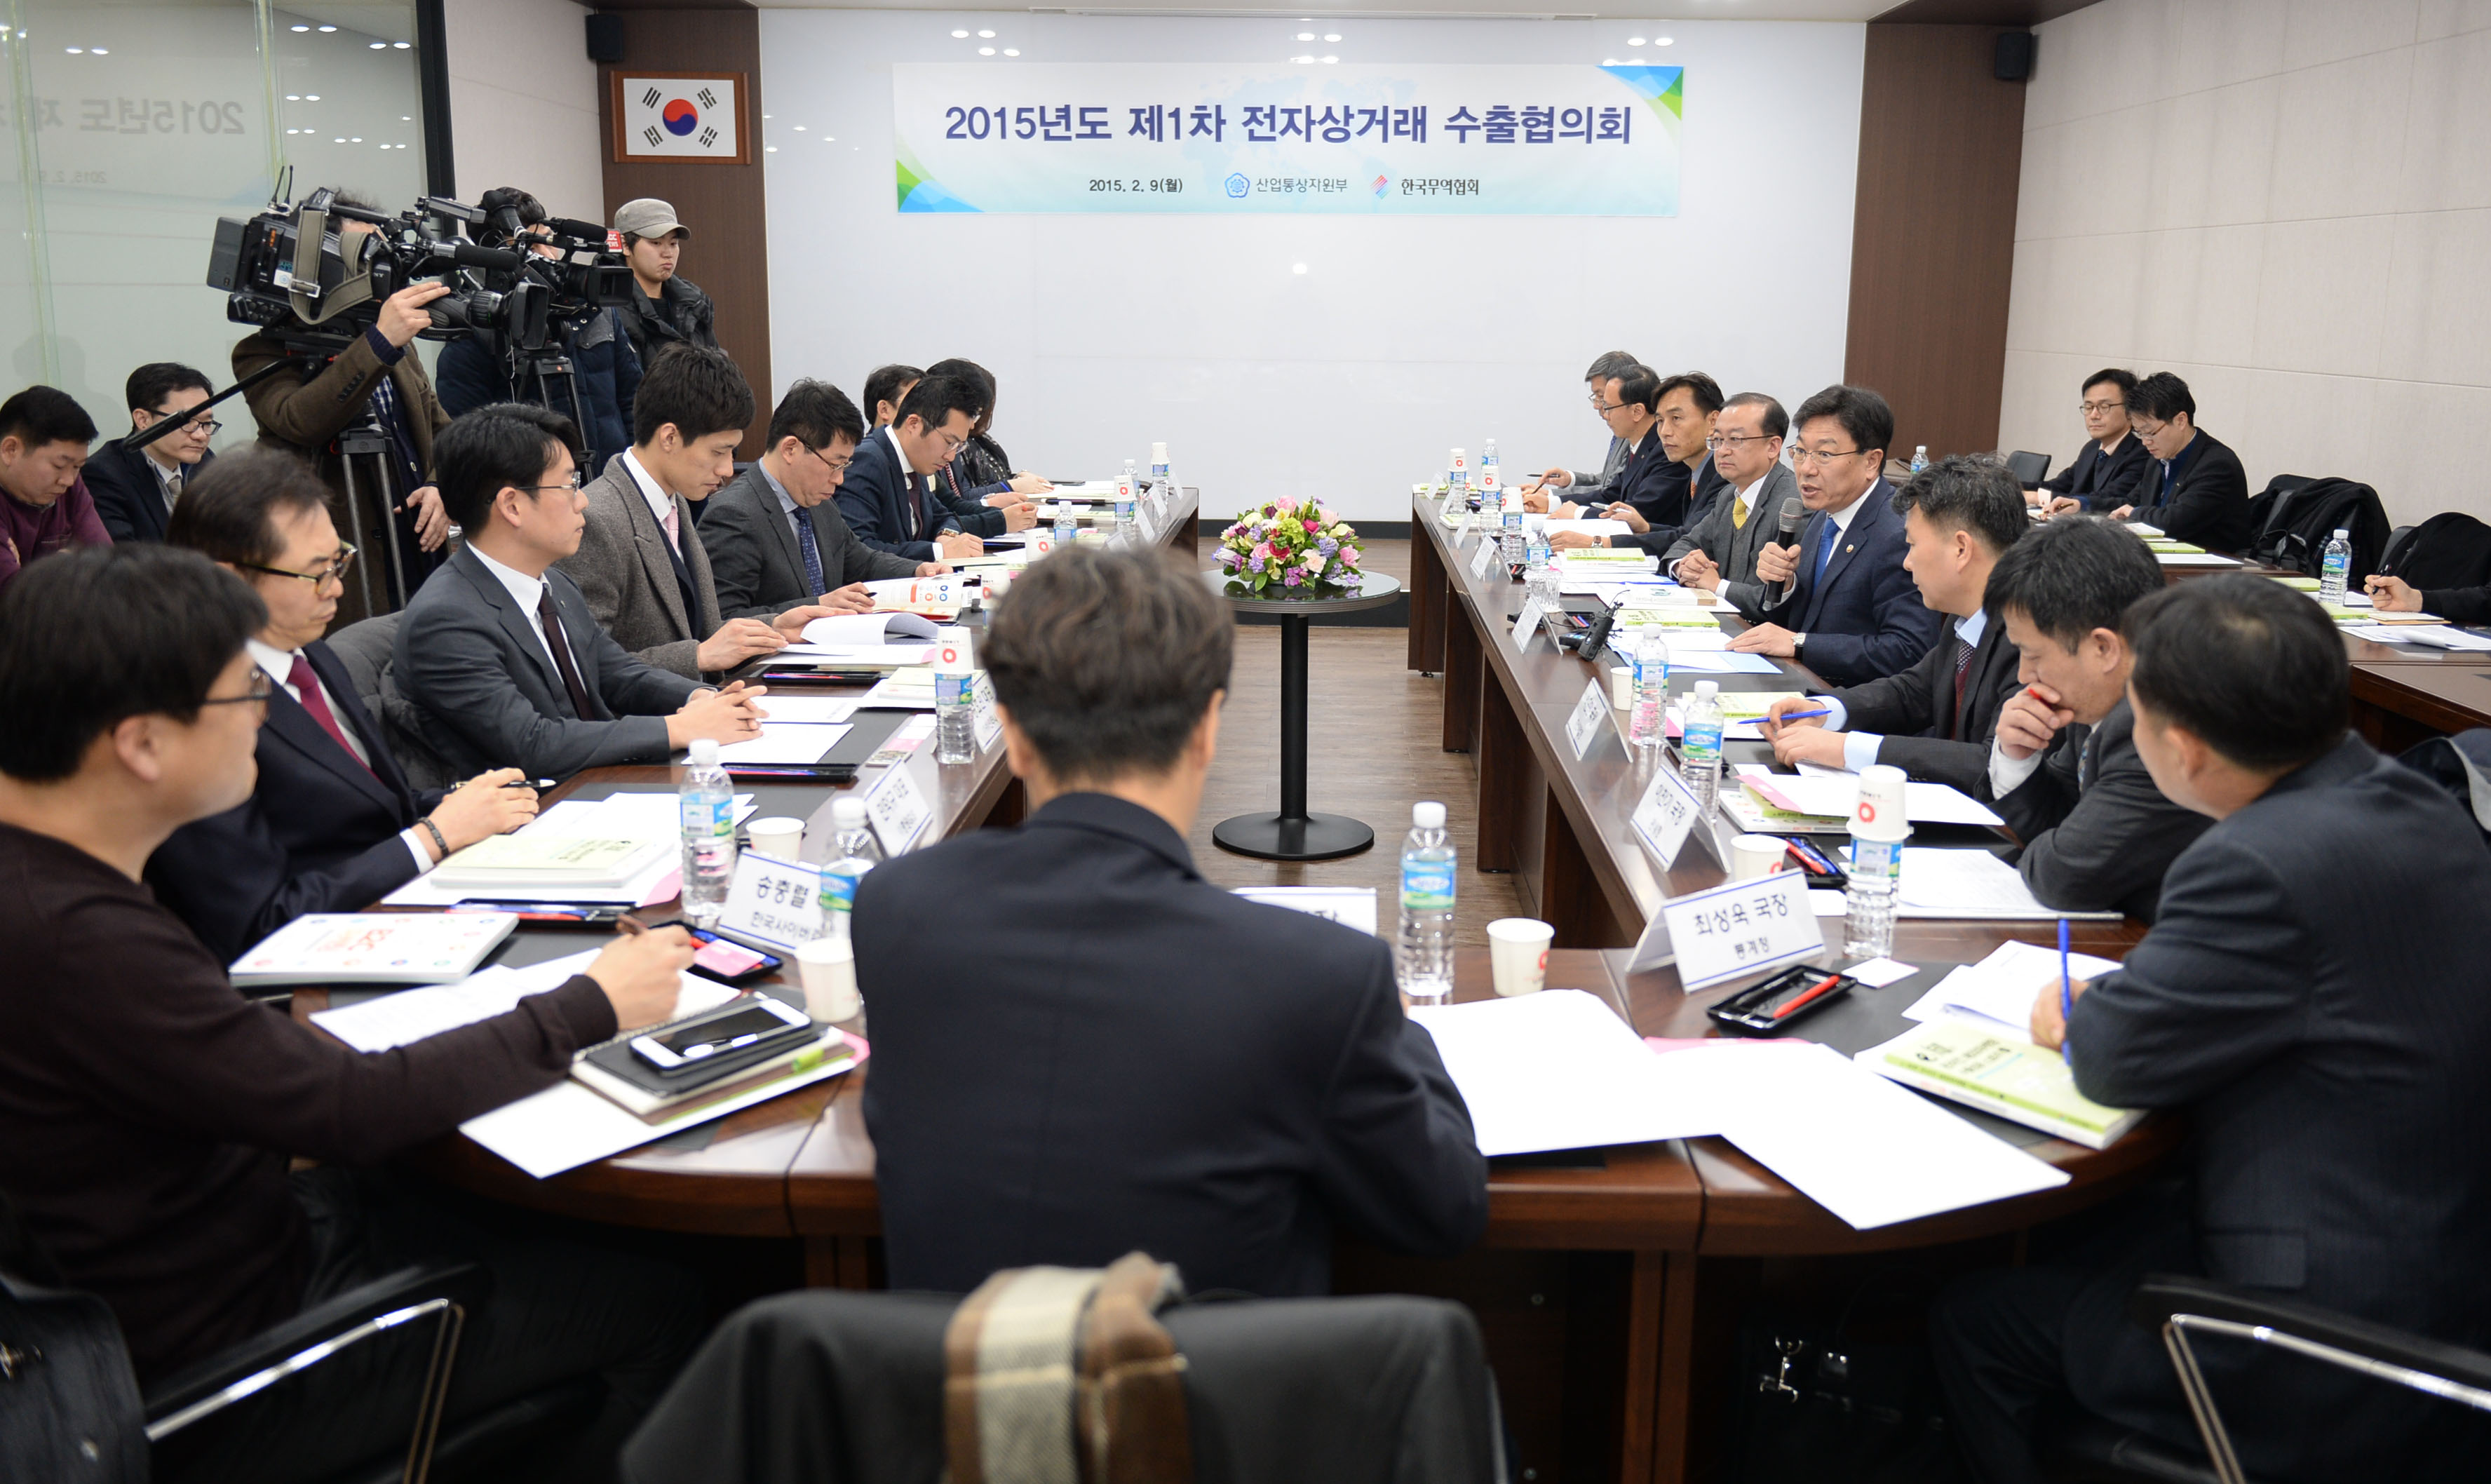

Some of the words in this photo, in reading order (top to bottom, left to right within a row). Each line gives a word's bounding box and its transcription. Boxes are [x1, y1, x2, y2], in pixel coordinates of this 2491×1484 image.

[945, 104, 1113, 142] 2015년도
[1127, 104, 1227, 142] 제1차
[1241, 104, 1427, 144] 전자상거래
[1443, 105, 1631, 144] 수출협의회
[1089, 179, 1126, 192] 2015.
[1132, 180, 1145, 192] 2.
[1149, 178, 1183, 193] 9(월)
[1256, 178, 1347, 194] 산업통상자원부
[1401, 178, 1480, 196] 한국무역협회
[1694, 903, 1749, 935] 최성욱
[1753, 893, 1788, 918] 국장
